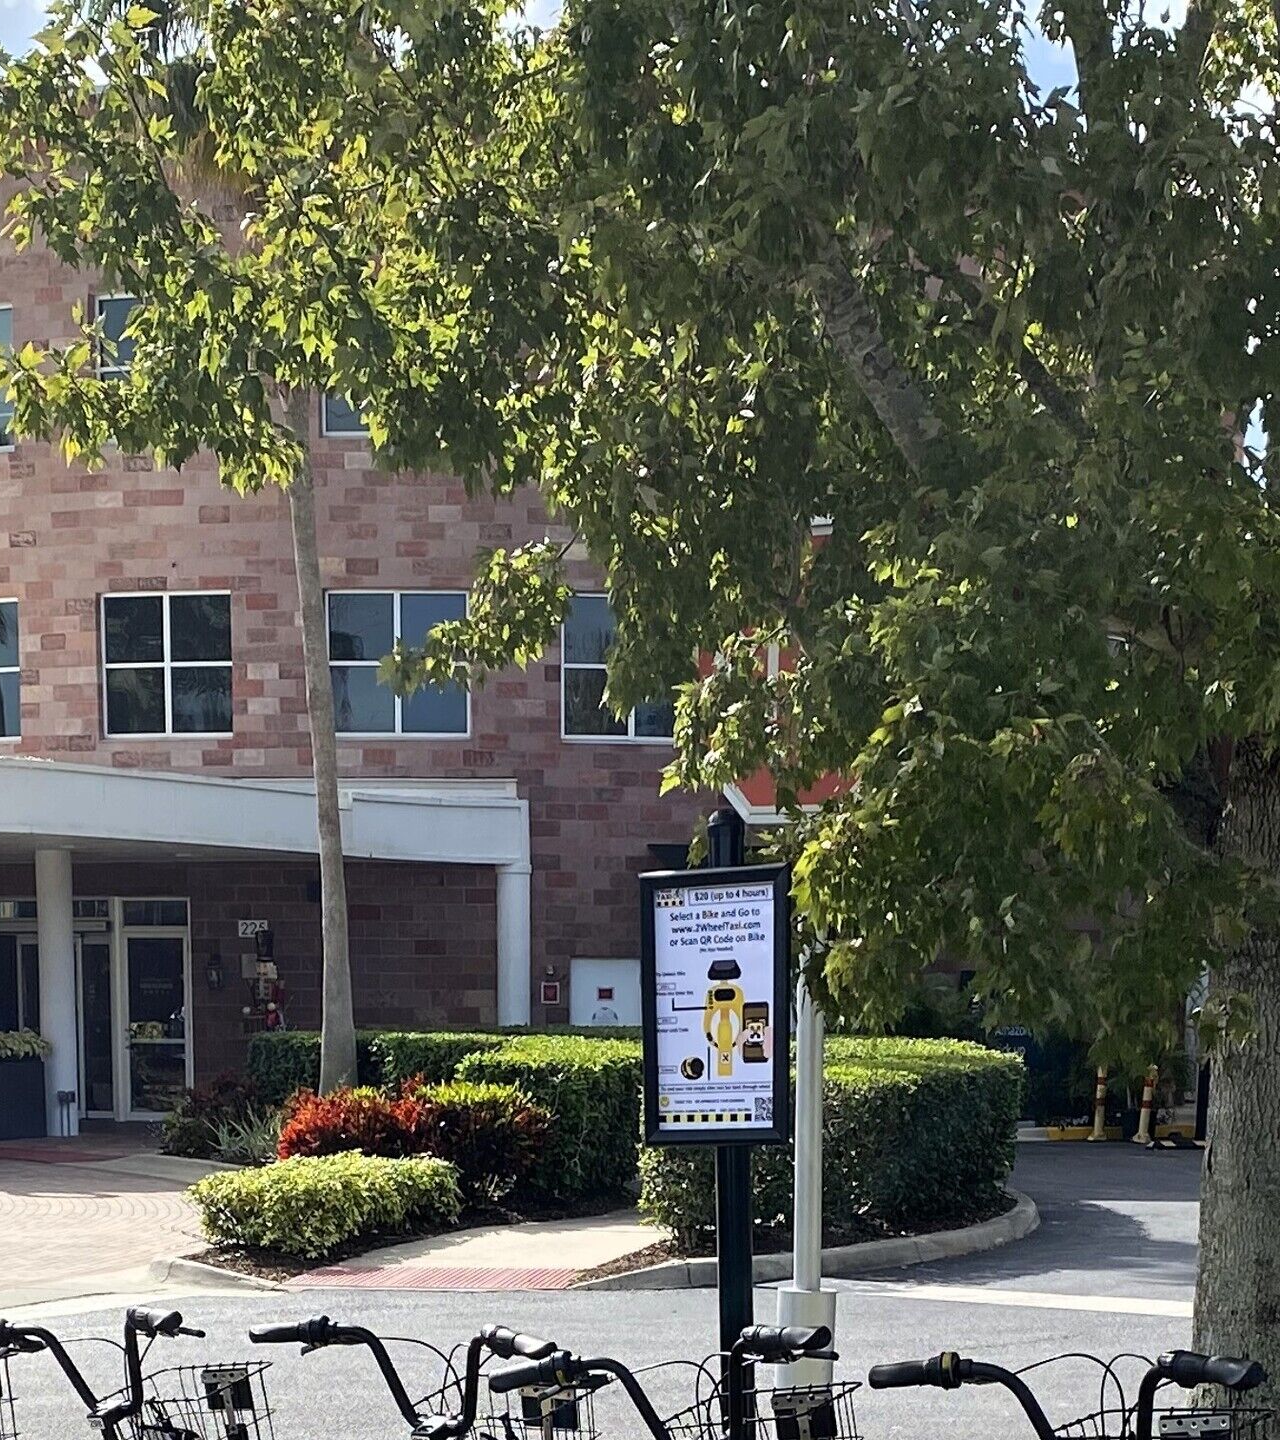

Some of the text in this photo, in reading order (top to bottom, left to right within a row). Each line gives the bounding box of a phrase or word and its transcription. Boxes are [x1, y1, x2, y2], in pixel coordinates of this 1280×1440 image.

[711, 891, 724, 902] (up
[726, 890, 734, 899] to
[742, 888, 769, 898] hours)
[670, 911, 693, 921] Select
[702, 910, 719, 919] Bike
[721, 909, 736, 918] and
[738, 907, 749, 917] Go
[751, 907, 760, 916] to
[669, 933, 765, 947] or Scan QR Code on Bike
